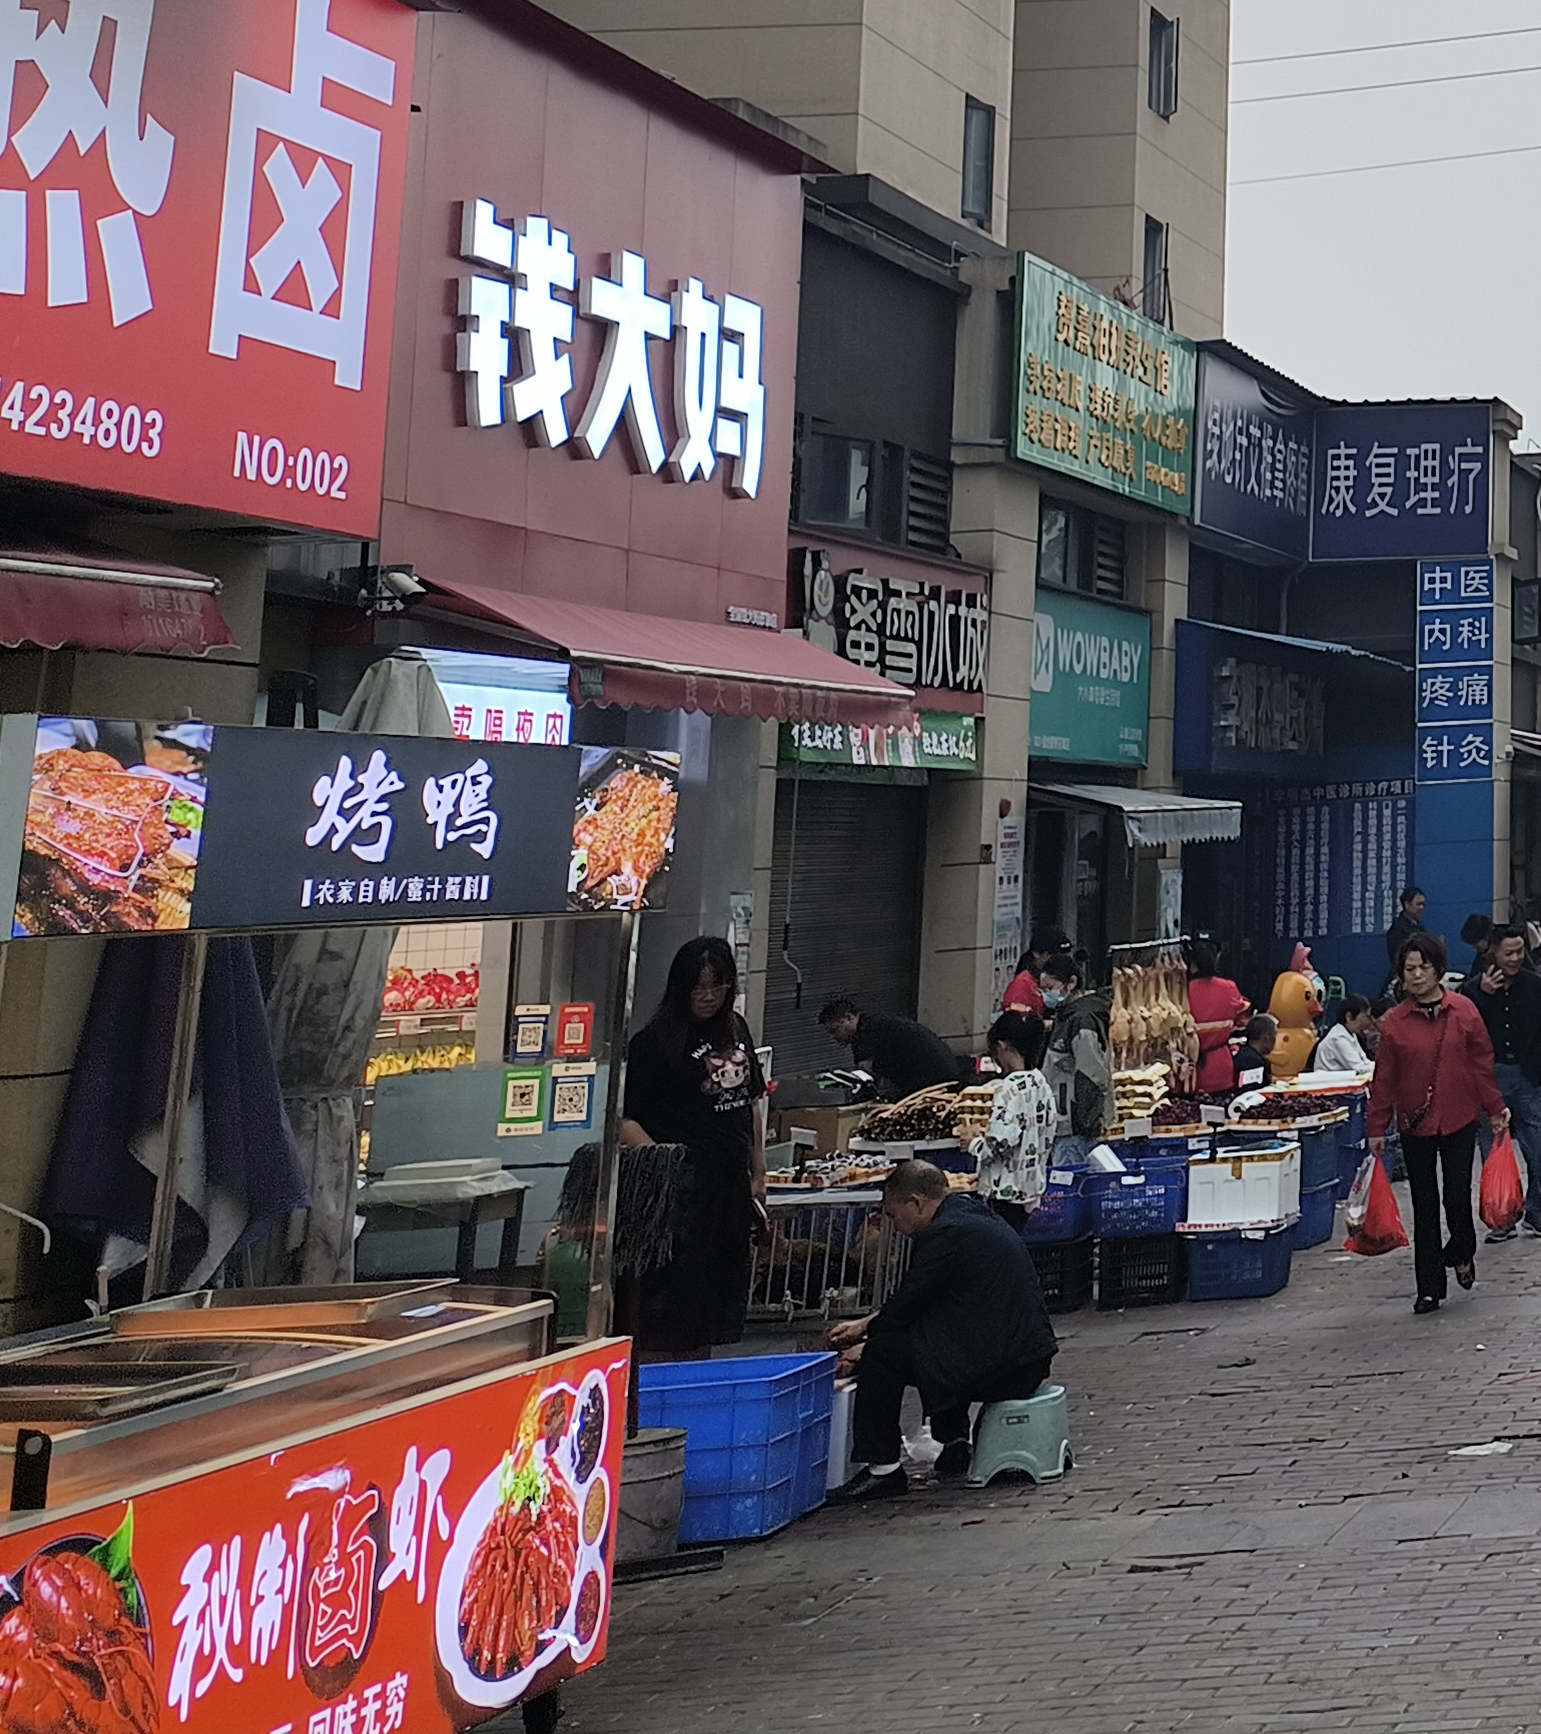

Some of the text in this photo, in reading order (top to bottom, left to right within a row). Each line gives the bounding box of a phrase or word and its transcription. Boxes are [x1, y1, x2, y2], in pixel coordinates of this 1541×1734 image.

[458, 197, 766, 500] 钱大妈
[0, 376, 349, 500] 4234803 NO:002
[1321, 437, 1484, 517] 康复理疗
[1424, 566, 1490, 600] 中医
[845, 569, 988, 691] 蜜雪冰城
[1057, 627, 1142, 684] WOWBABY
[1424, 617, 1490, 650] 内科
[1422, 673, 1490, 707] 疼痛
[453, 704, 564, 745] 卖隔夜肉
[1422, 734, 1490, 768] 针灸
[305, 749, 499, 863] 烤鸭
[168, 1445, 451, 1723] 秘制卤虾
[308, 1671, 408, 1734] 回味无穷
